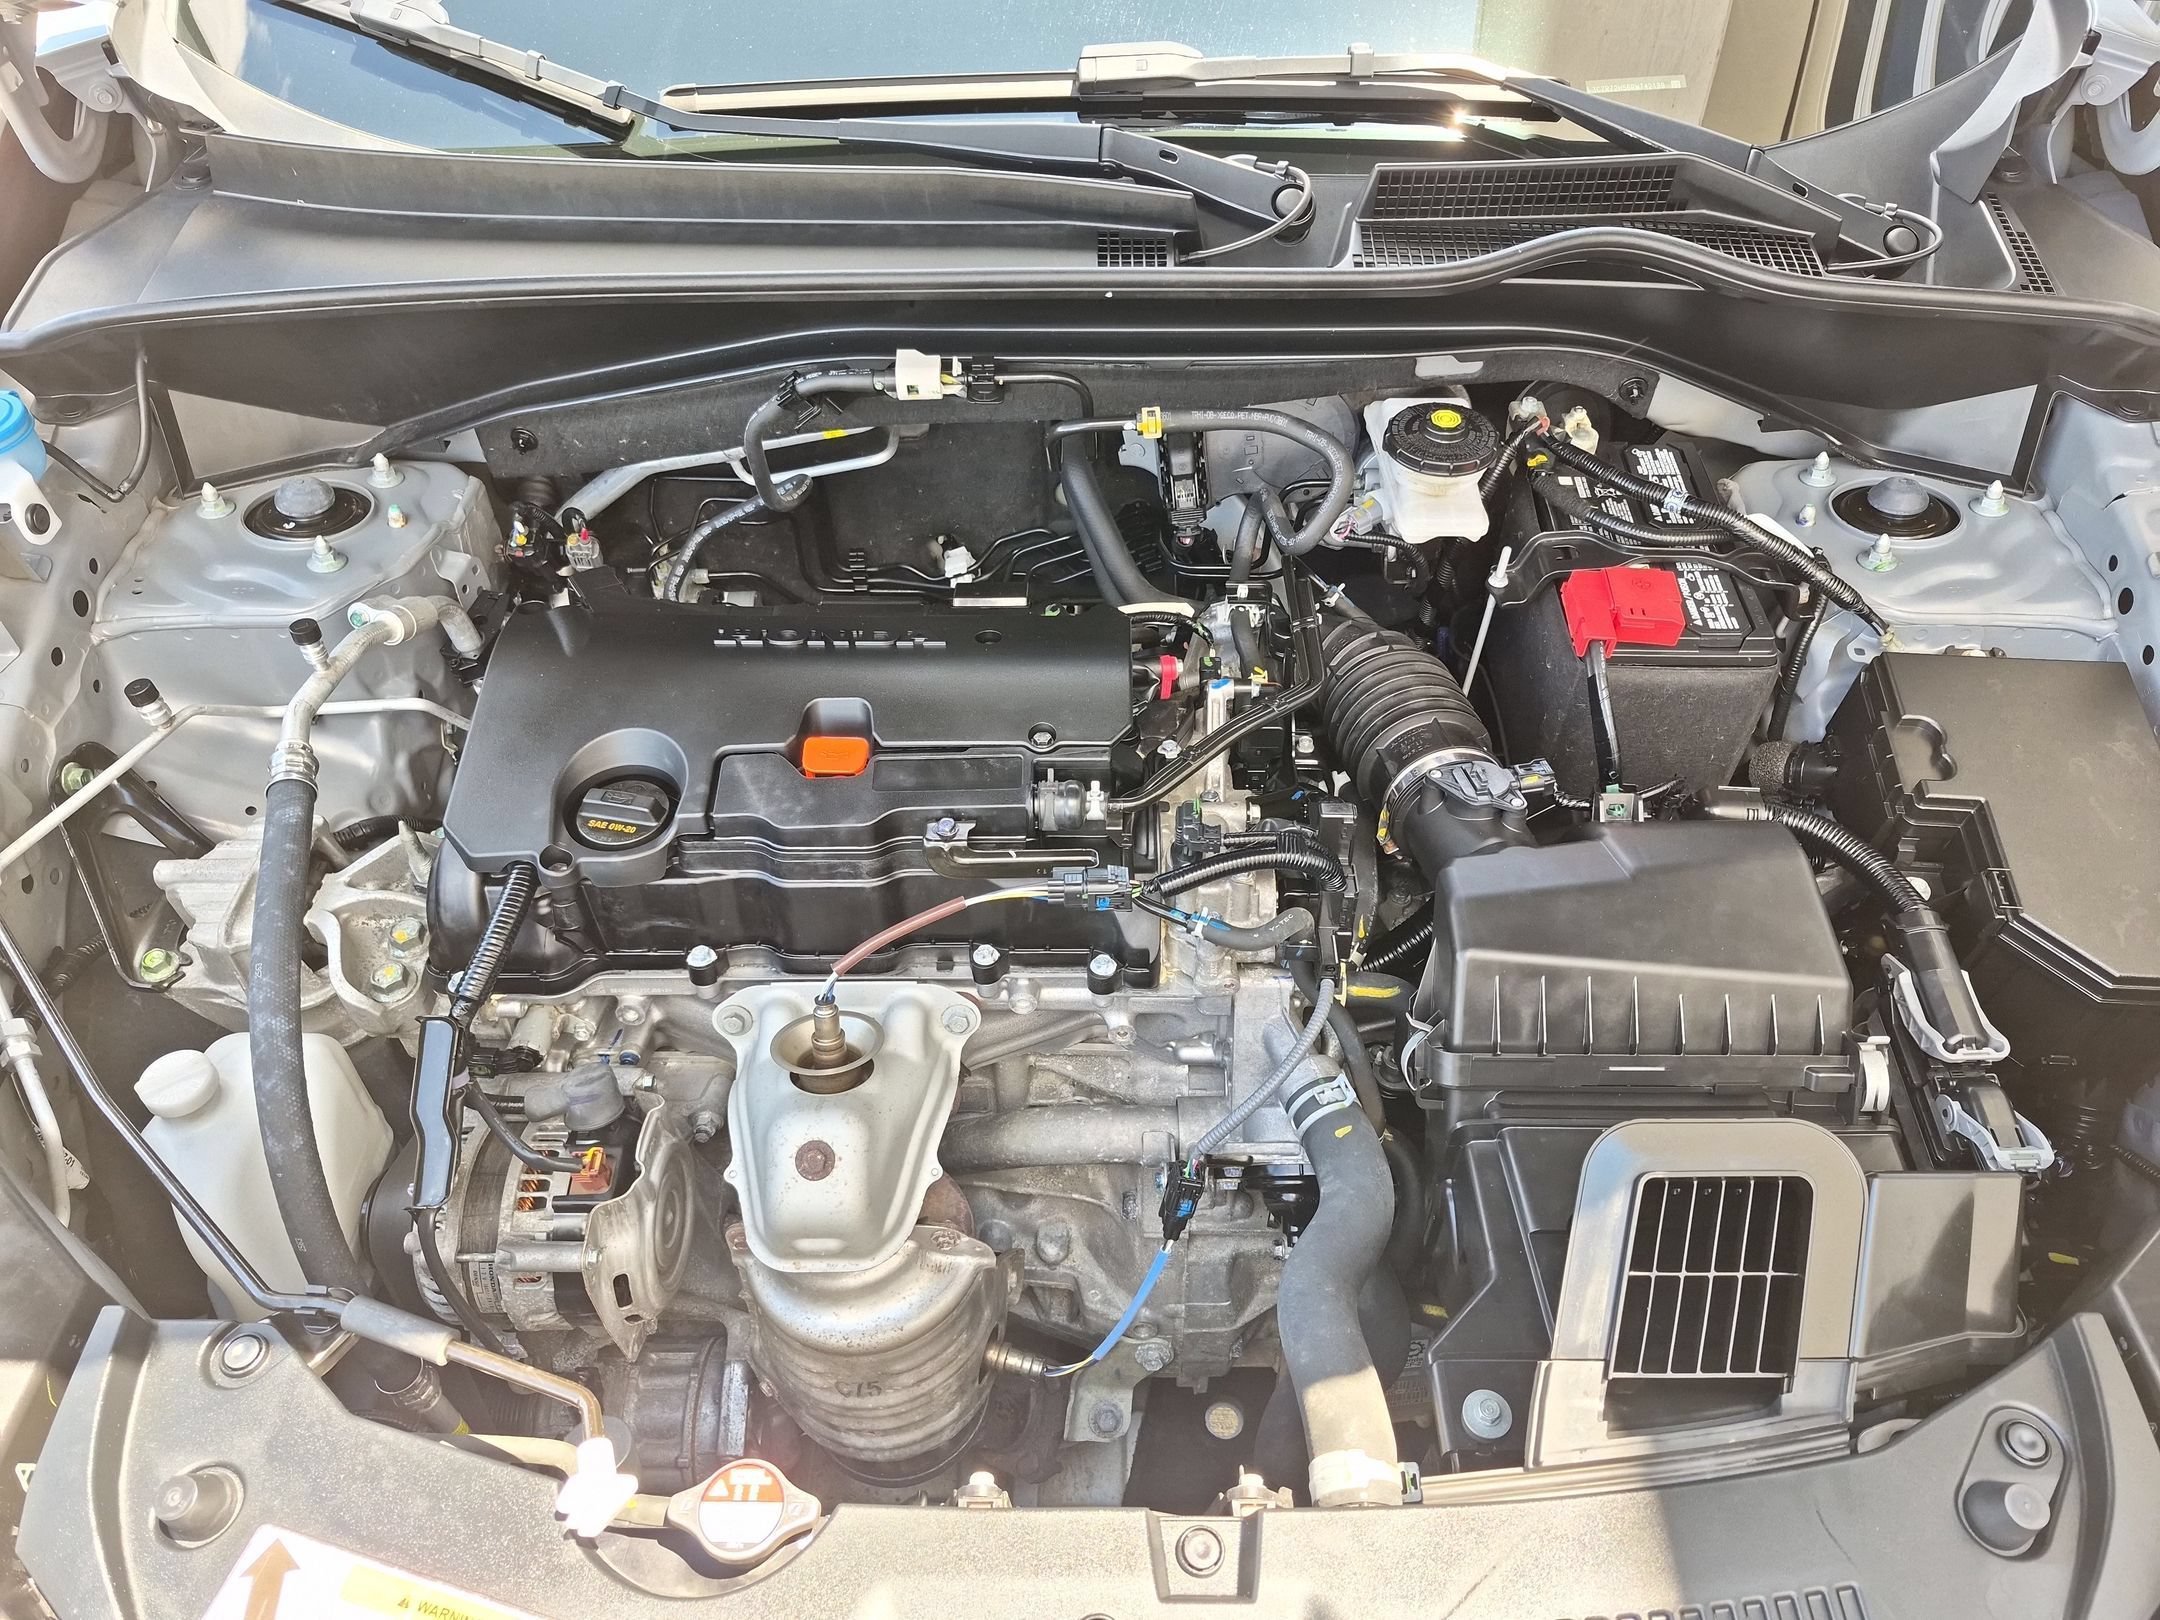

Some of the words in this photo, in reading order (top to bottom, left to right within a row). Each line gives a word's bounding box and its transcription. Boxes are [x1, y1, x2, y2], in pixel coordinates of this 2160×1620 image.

[588, 820, 608, 829] SAE
[608, 823, 637, 833] 0W-20
[418, 1600, 472, 1620] WARN
